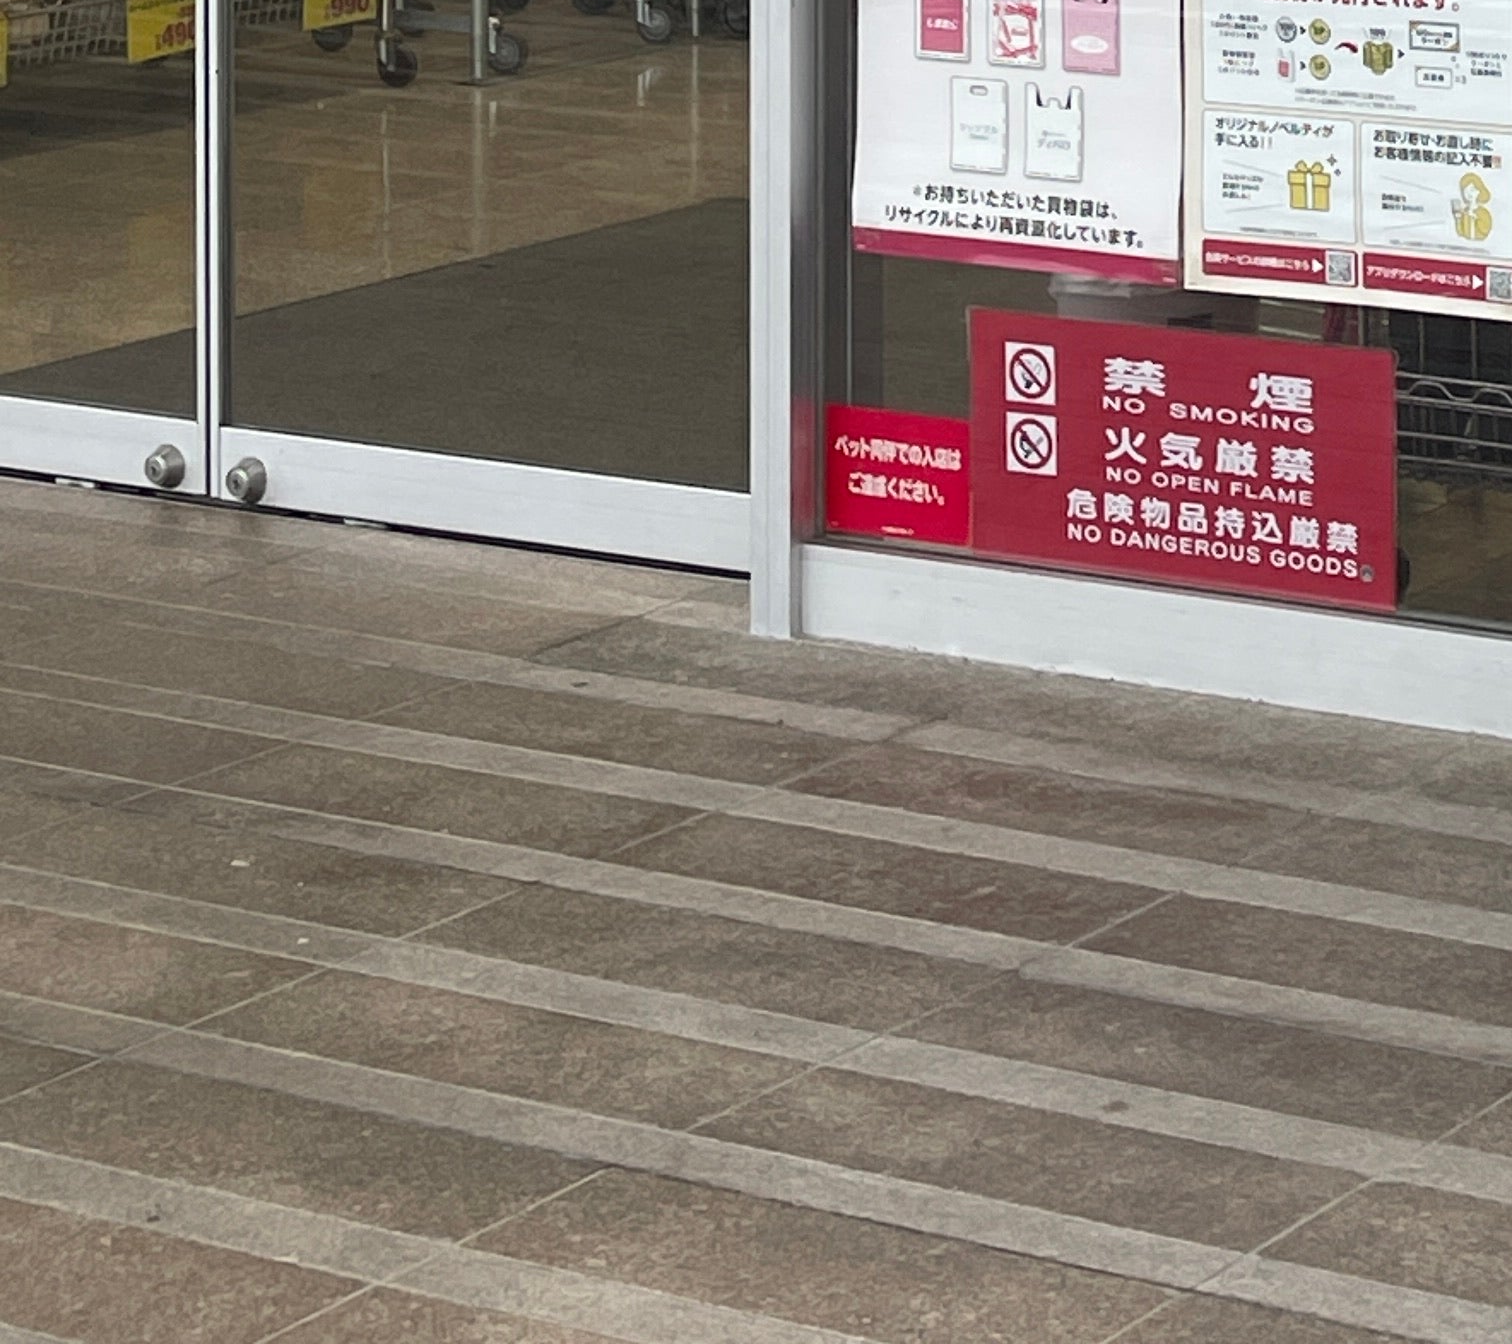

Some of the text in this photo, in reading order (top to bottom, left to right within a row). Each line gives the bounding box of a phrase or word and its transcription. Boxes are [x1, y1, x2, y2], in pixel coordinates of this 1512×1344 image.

[885, 204, 1144, 249] リサイクルにより再資源化しています。
[1103, 395, 1316, 435] NO SMOKING
[1103, 426, 1315, 485] 火気厳禁
[1105, 466, 1314, 507] NO OPEN FLAME
[1066, 488, 1360, 556] 危険物品持込厳禁
[1066, 522, 1359, 579] NO DANGEROUS GOODS
